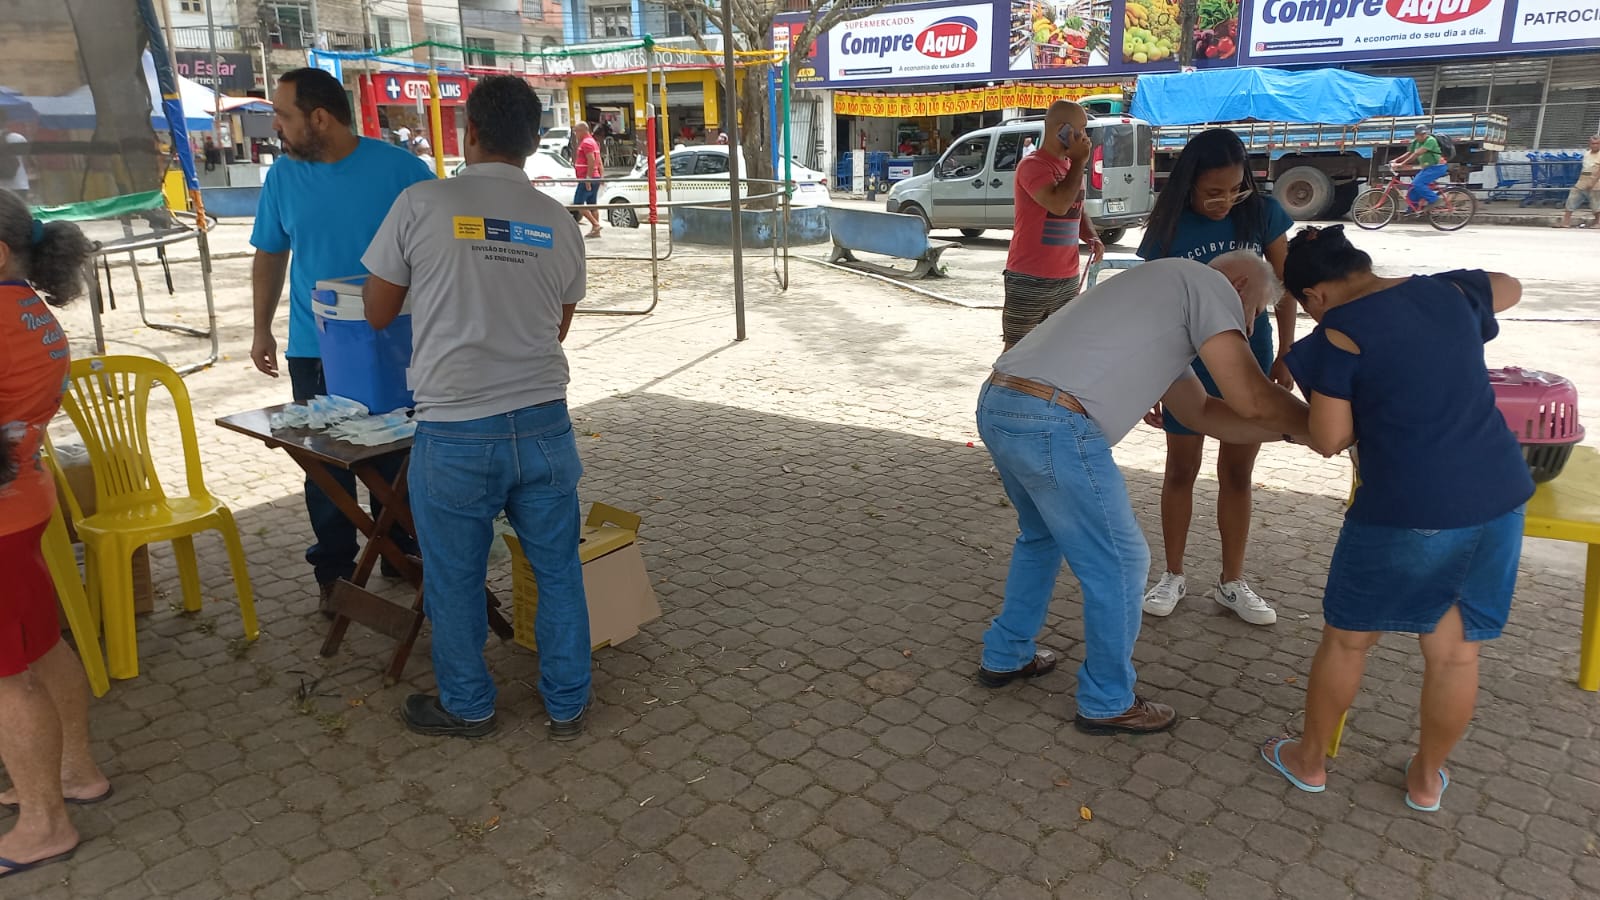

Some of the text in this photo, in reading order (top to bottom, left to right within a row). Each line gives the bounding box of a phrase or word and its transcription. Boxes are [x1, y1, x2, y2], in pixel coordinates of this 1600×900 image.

[1262, 0, 1383, 27] Compre
[1523, 8, 1600, 26] PATROCI
[844, 17, 915, 30] SUPERMERCADOS
[840, 25, 968, 58] Compre Aqui
[1354, 36, 1362, 44] A
[1363, 33, 1408, 43] economia
[1409, 31, 1422, 40] do
[1443, 29, 1458, 37] dia
[1469, 27, 1487, 36] dia.
[654, 51, 673, 66] DO
[440, 83, 462, 97] LINS
[1209, 241, 1225, 252] BY
